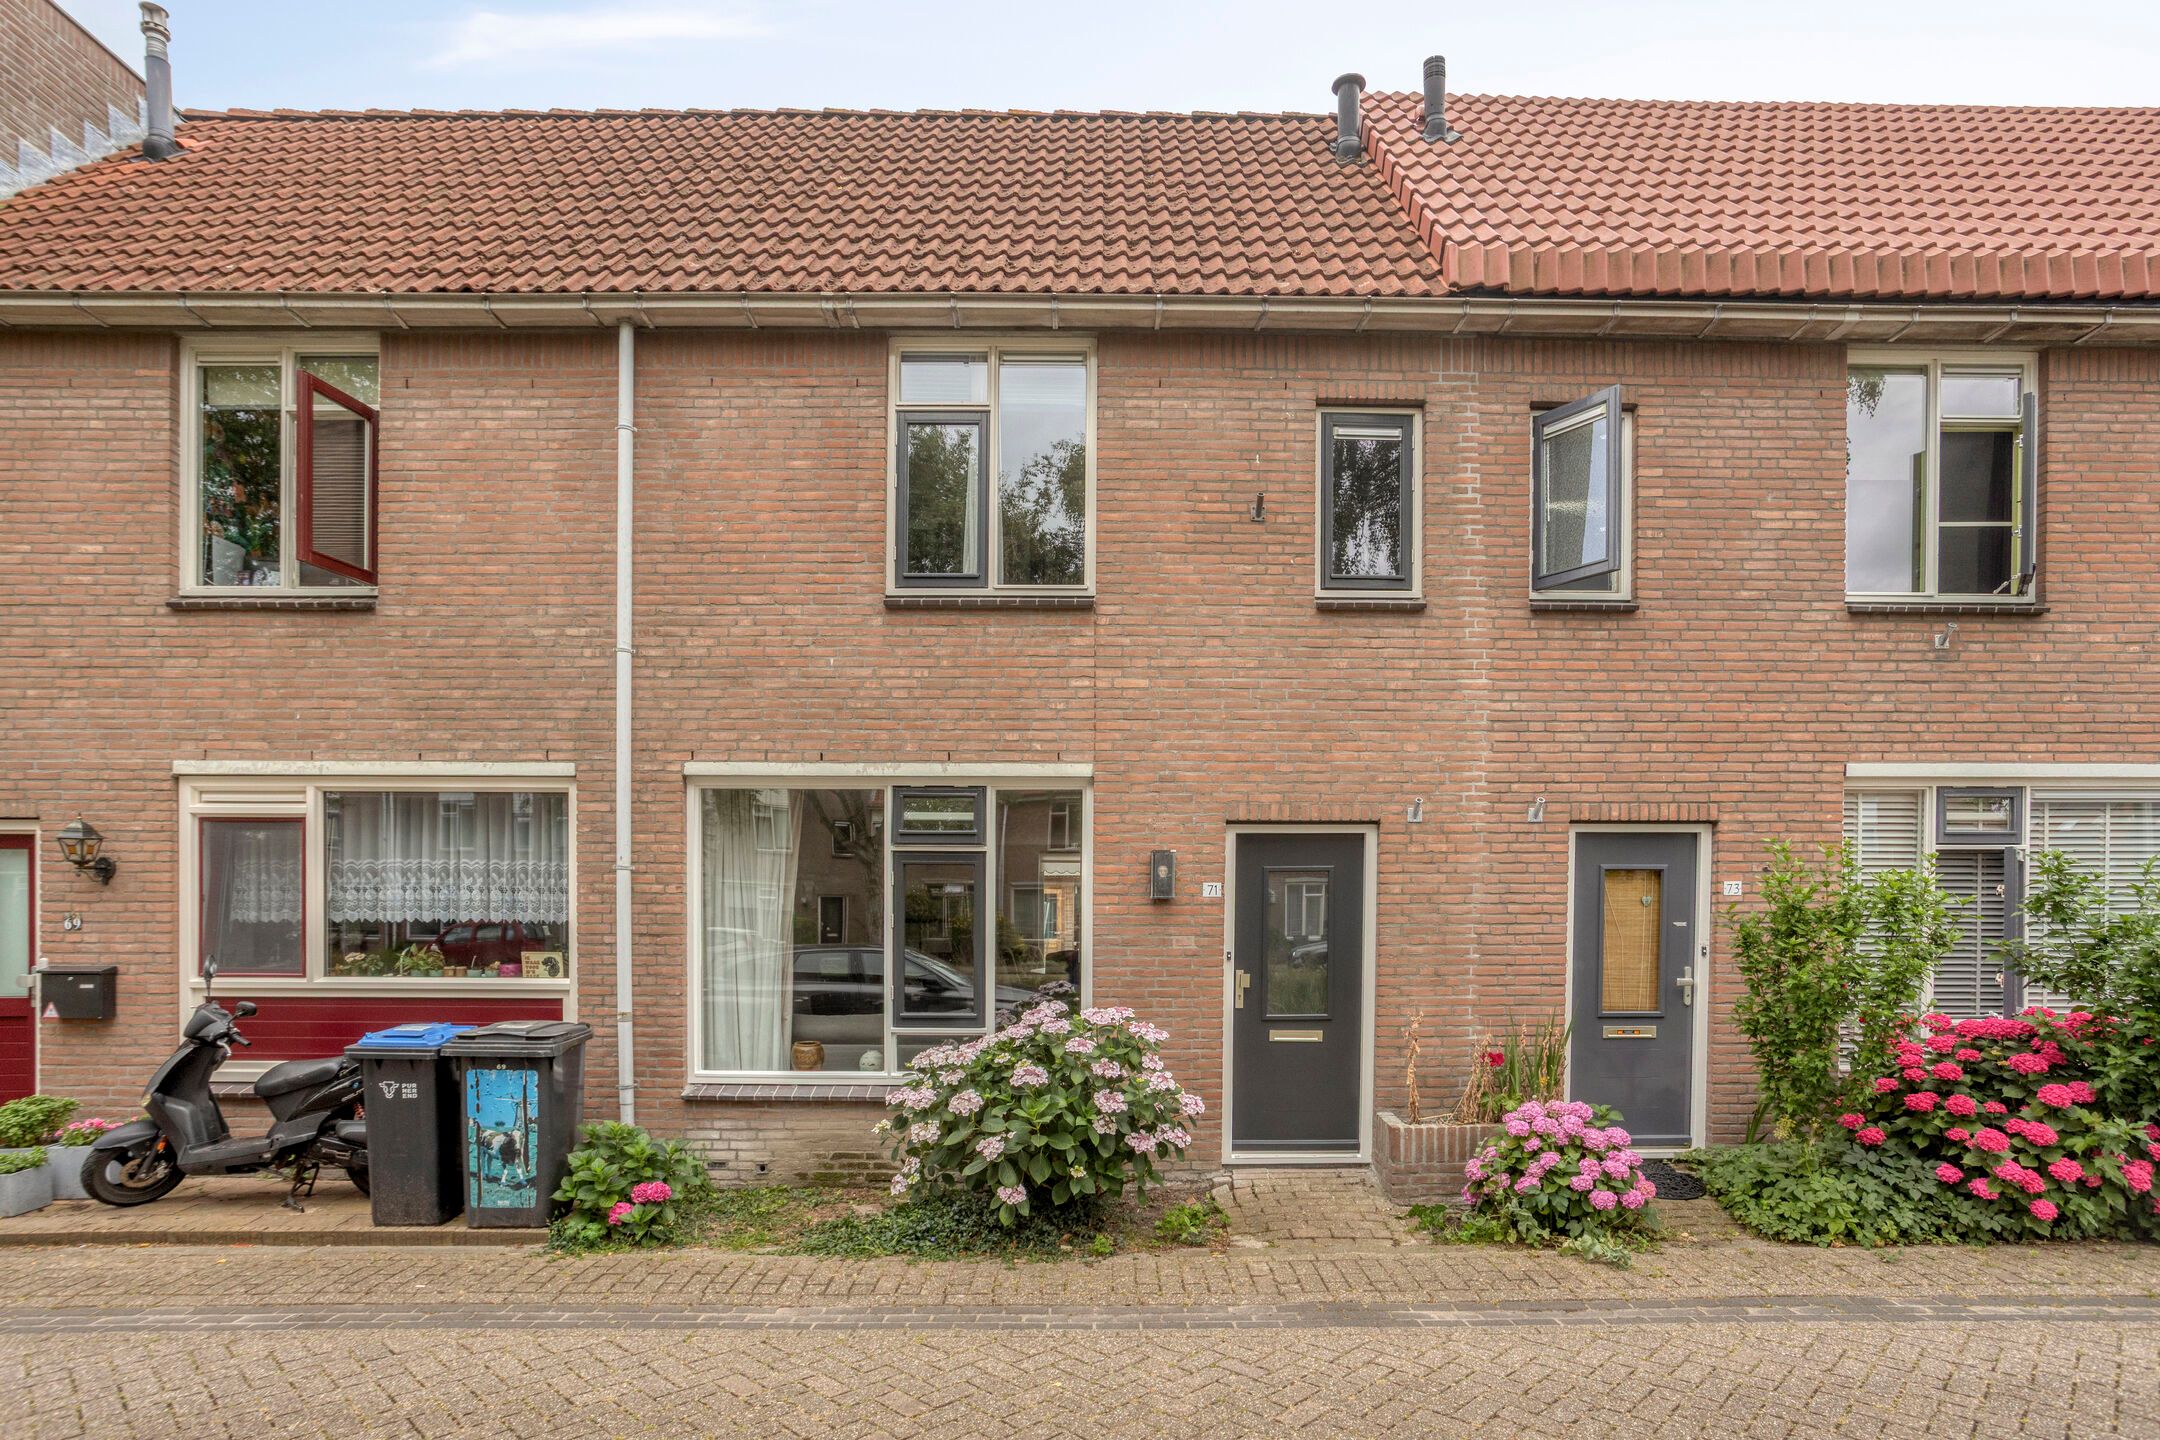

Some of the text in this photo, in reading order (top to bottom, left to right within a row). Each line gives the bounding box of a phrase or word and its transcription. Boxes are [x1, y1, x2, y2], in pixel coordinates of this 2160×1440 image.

[1207, 884, 1218, 895] 71
[1726, 883, 1740, 894] 73
[64, 917, 81, 930] 69
